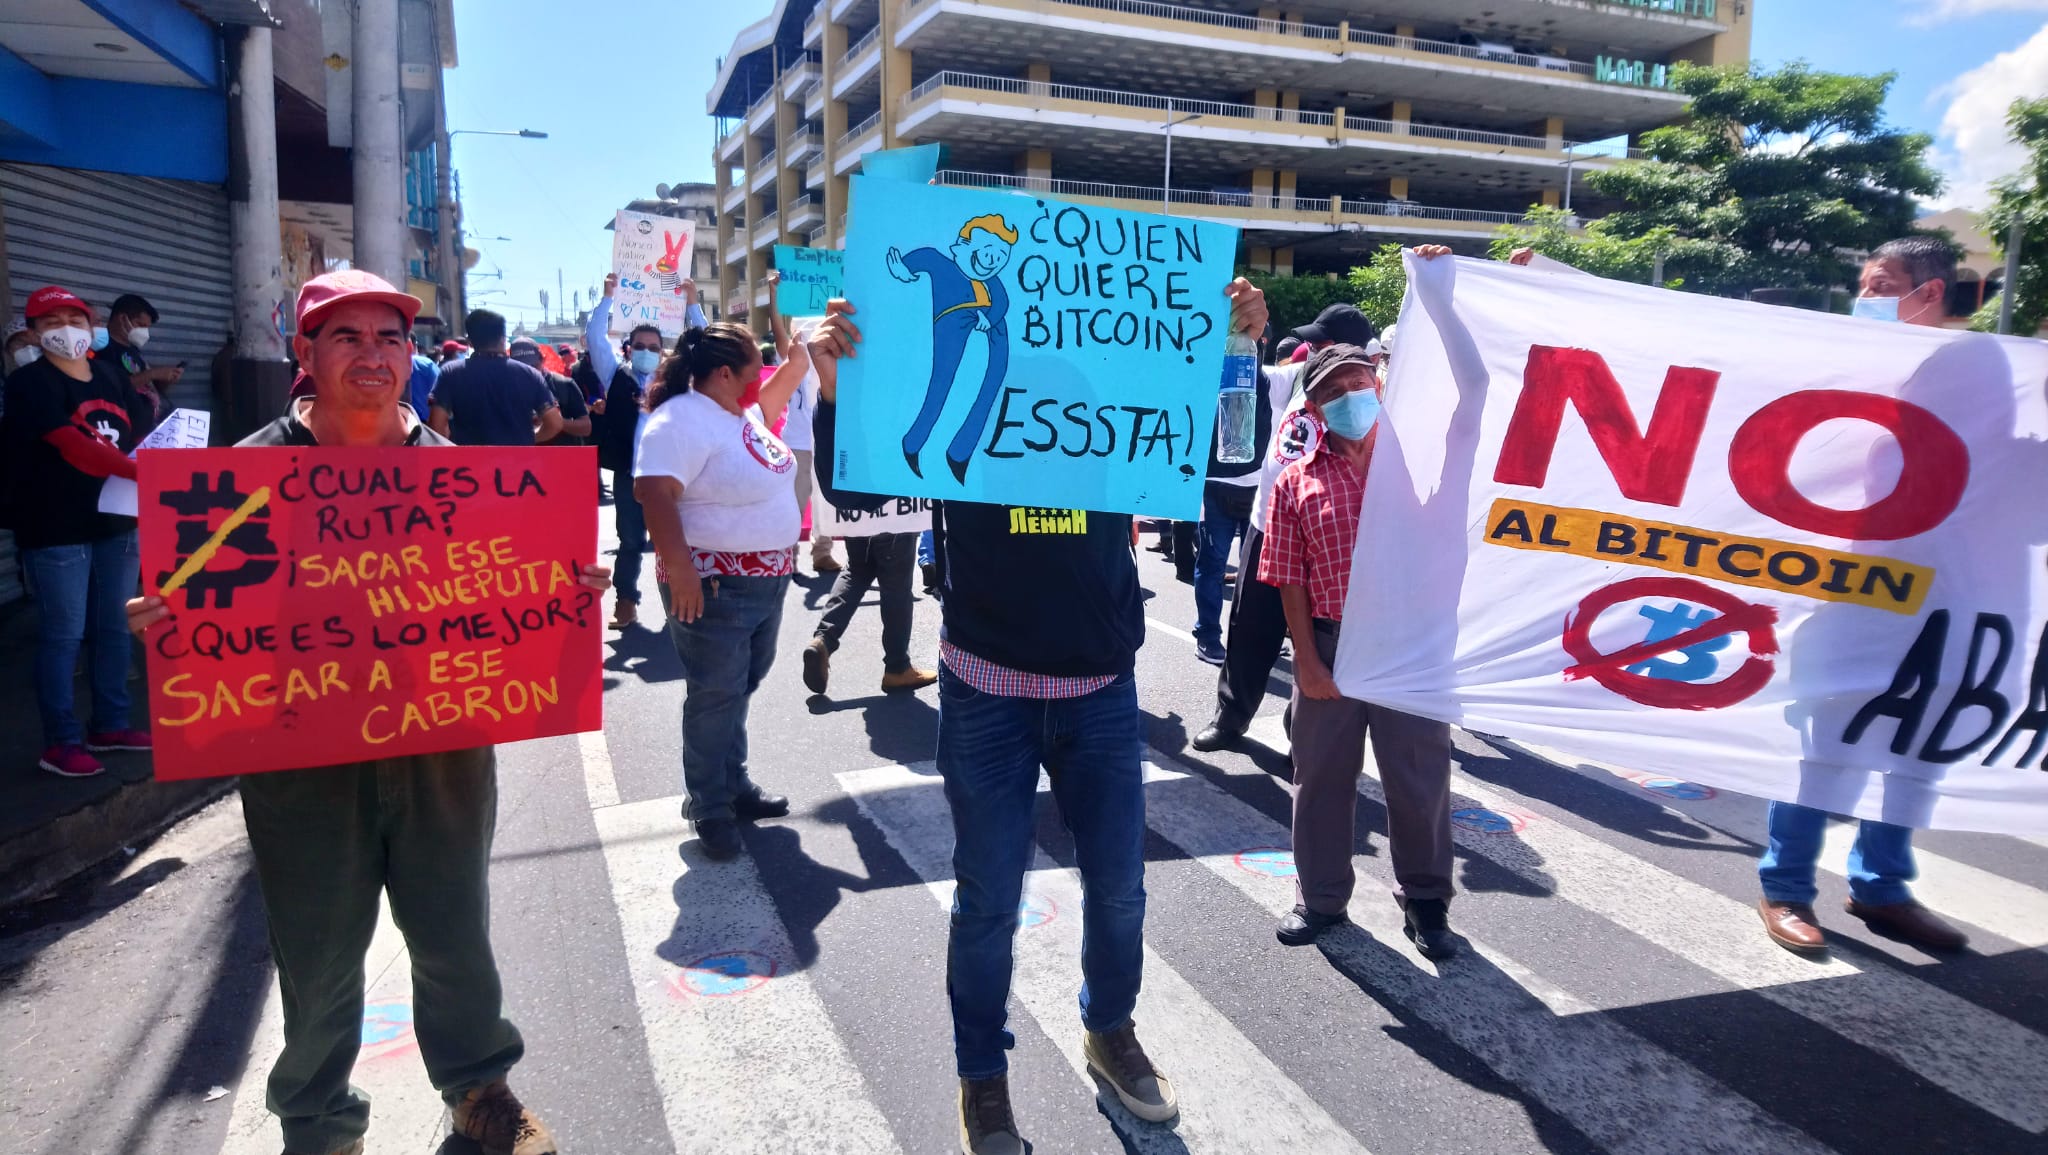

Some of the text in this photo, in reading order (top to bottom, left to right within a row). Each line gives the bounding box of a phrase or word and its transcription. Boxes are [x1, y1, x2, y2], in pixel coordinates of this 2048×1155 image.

[1030, 199, 1203, 264] ¿QUIEN
[1018, 254, 1194, 311] QUIERE
[983, 386, 1196, 478] ESSSTA!
[1493, 344, 1970, 541] NO
[279, 456, 546, 501] ¿CUAL ES LA
[316, 501, 457, 543] RUTA?
[448, 536, 518, 571] ESE
[367, 559, 581, 617] HIJUEPUTA!
[1491, 509, 1917, 605] AL BITCOIN
[373, 622, 427, 650] LO
[439, 591, 594, 646] MEJOR?
[159, 647, 504, 727] SACAR A ESE
[361, 676, 559, 745] CABRON
[1841, 608, 2048, 772] ABA
